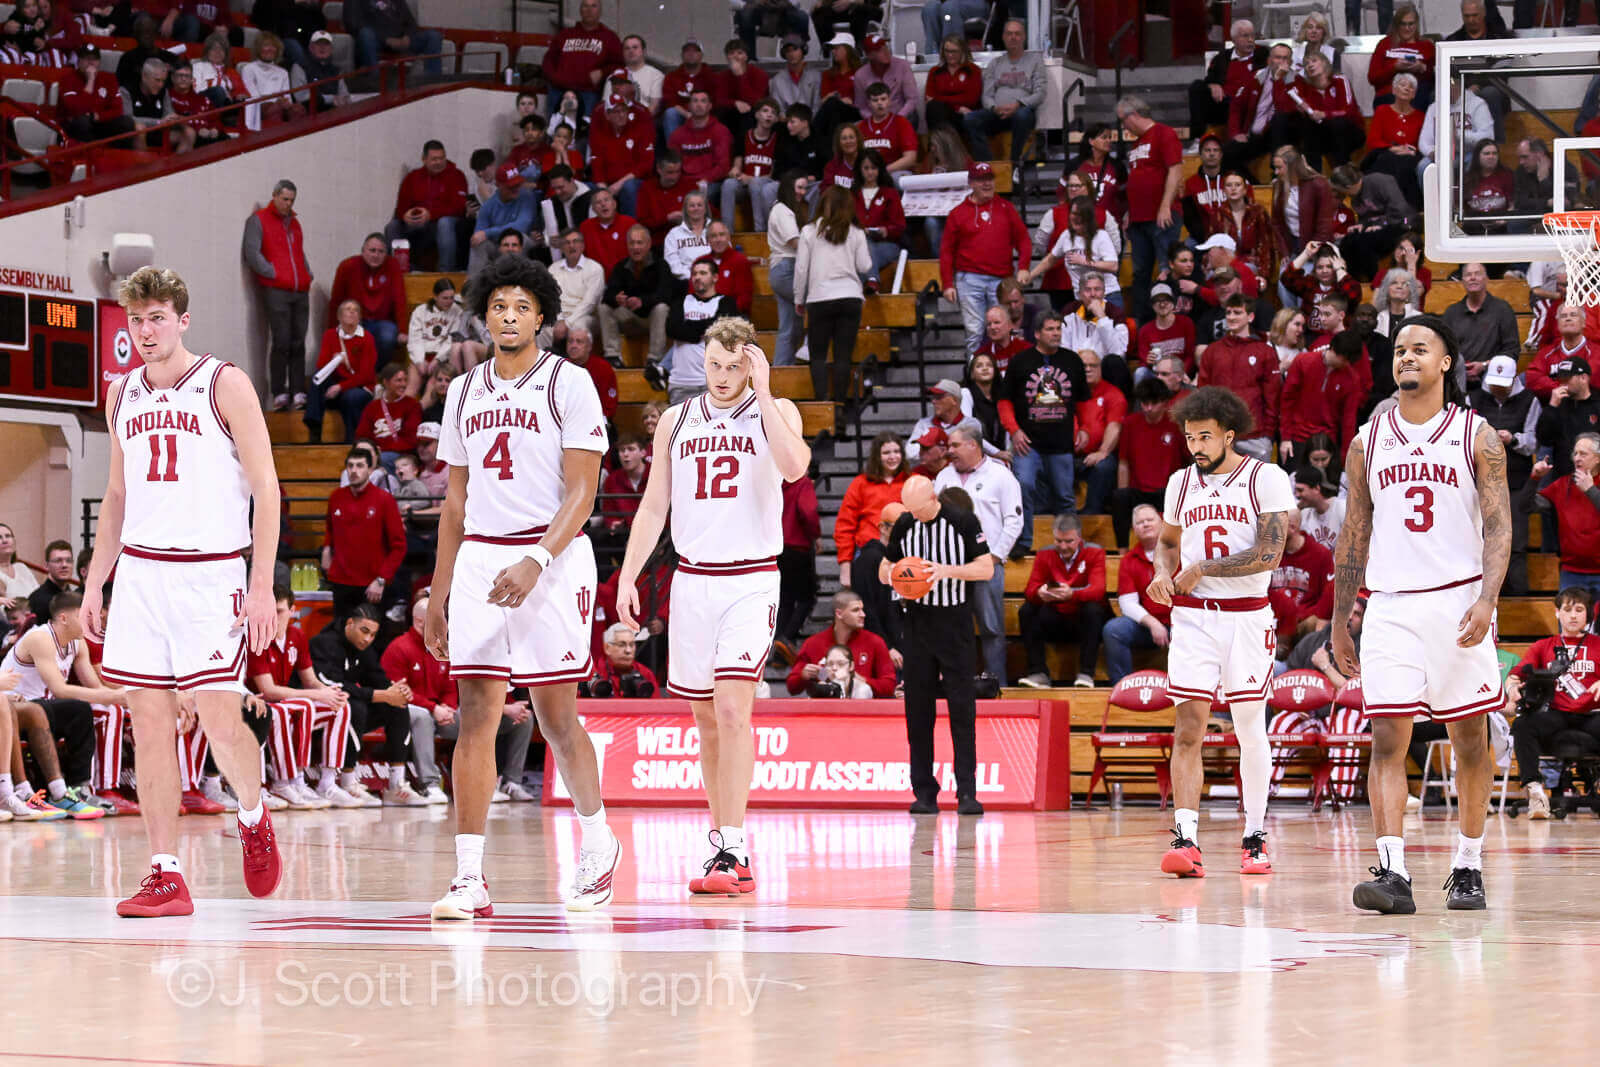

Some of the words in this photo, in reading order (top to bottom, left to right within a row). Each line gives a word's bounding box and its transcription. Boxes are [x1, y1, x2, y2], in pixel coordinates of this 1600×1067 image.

[47, 274, 74, 293] HALL
[126, 410, 202, 440] INDIANA
[465, 408, 541, 438] INDIANA
[147, 434, 179, 481] 11
[482, 432, 513, 480] 4
[680, 436, 757, 460] INDIANA
[695, 456, 740, 500] 12
[1377, 463, 1459, 490] INDIANA
[1184, 504, 1250, 528] INDIANA
[1404, 486, 1434, 533] 3
[1204, 525, 1230, 560] 6
[1273, 675, 1325, 690] INDIANA
[636, 726, 754, 756] WELC
[757, 727, 788, 756] TO
[942, 763, 1004, 792] HLL
